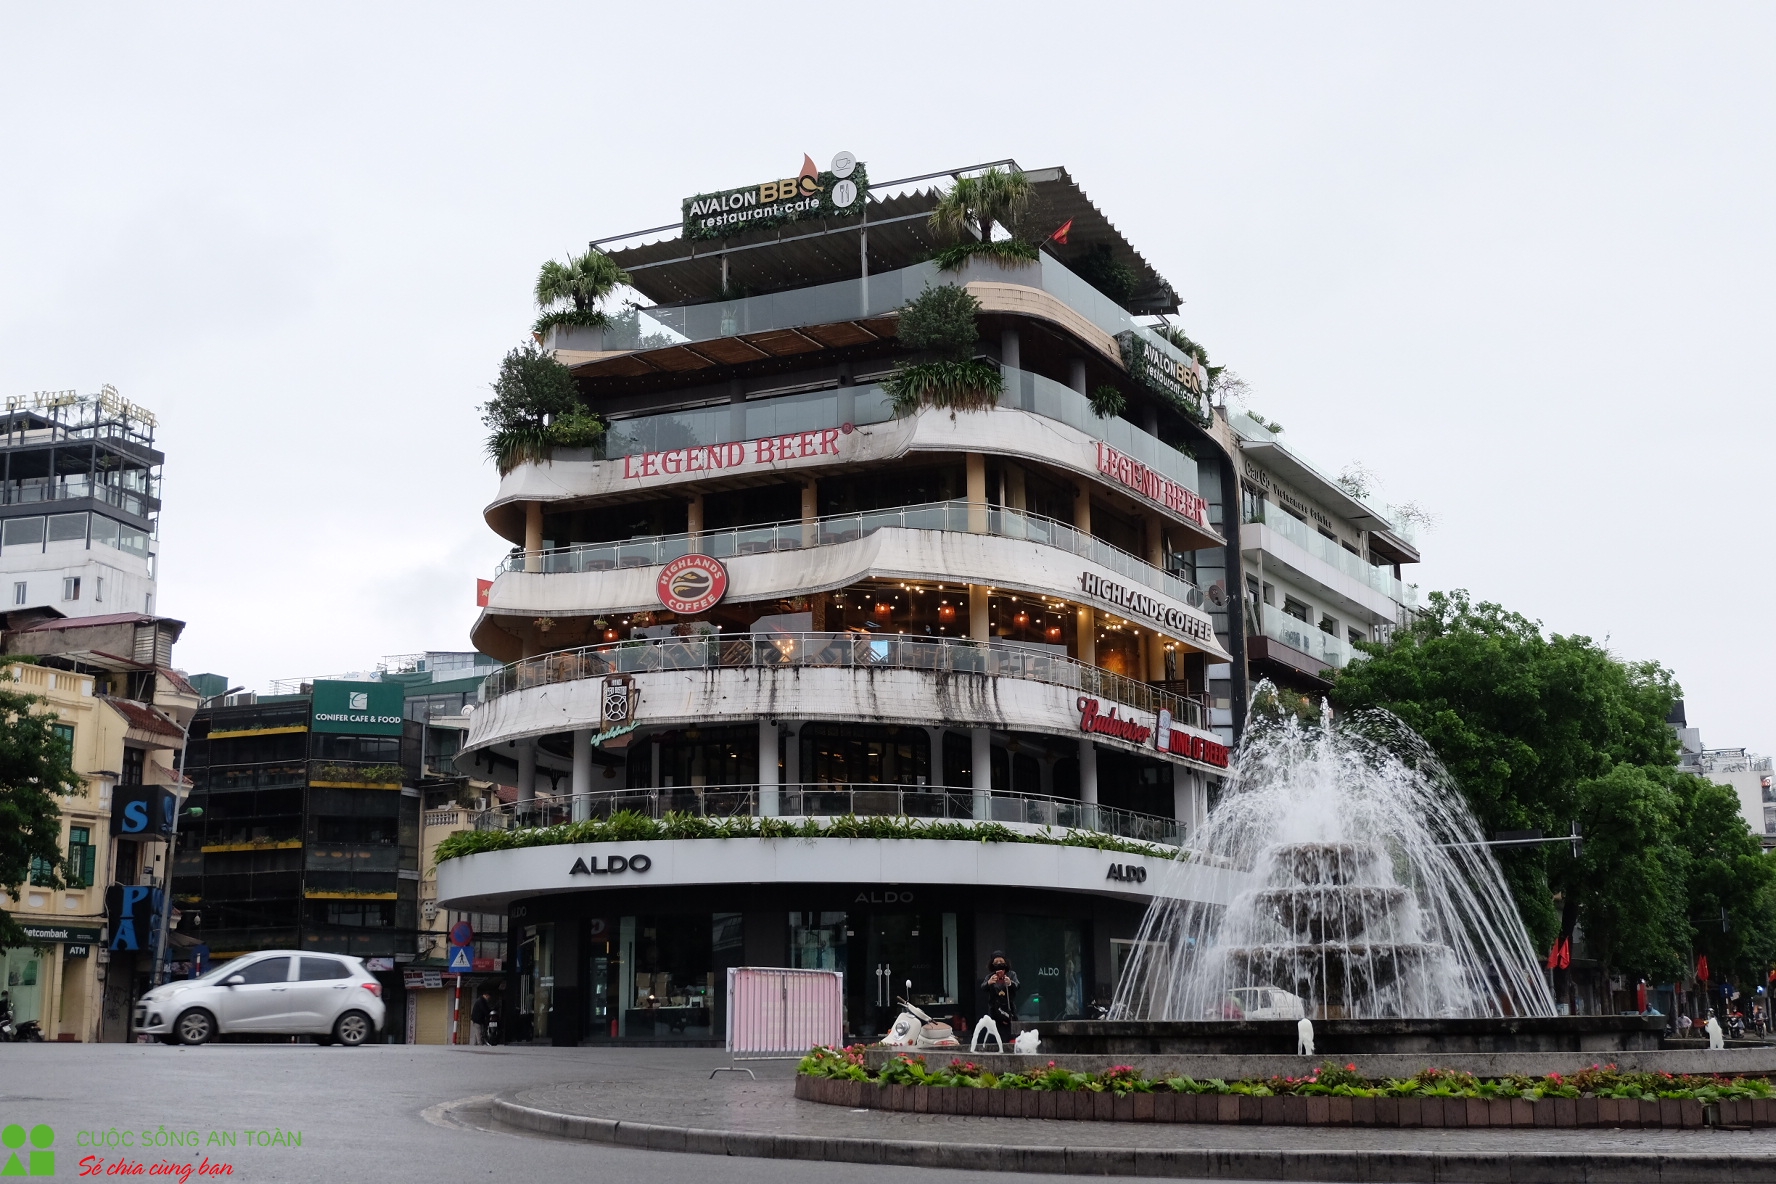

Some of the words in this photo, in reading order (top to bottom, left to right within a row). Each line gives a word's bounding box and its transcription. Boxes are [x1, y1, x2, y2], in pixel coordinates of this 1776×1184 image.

[690, 190, 757, 217] AVALON
[1143, 343, 1176, 378] AVALON
[6, 395, 26, 411] DE
[623, 441, 745, 479] LEGEND
[755, 428, 840, 464] BEER
[1097, 443, 1164, 500] LEGEND
[1164, 481, 1204, 527] BEER
[660, 557, 722, 586] HIGHLANDS
[668, 593, 716, 611] COFFEE
[1083, 571, 1167, 622] HIGHLANDS
[1166, 607, 1212, 642] COFFEE
[315, 713, 348, 722] CONIFER
[350, 714, 369, 723] CAFE
[370, 715, 376, 723] &
[378, 716, 401, 724] FOOD
[1077, 696, 1152, 744] Budweiser
[1170, 729, 1191, 757] KING
[1191, 736, 1204, 761] OF
[1204, 740, 1230, 769] BEERS
[569, 853, 652, 875] ALDO
[1107, 863, 1147, 883] ALDO
[854, 891, 914, 904] ALDO
[69, 946, 86, 955] ATM
[1038, 967, 1060, 977] ALDO
